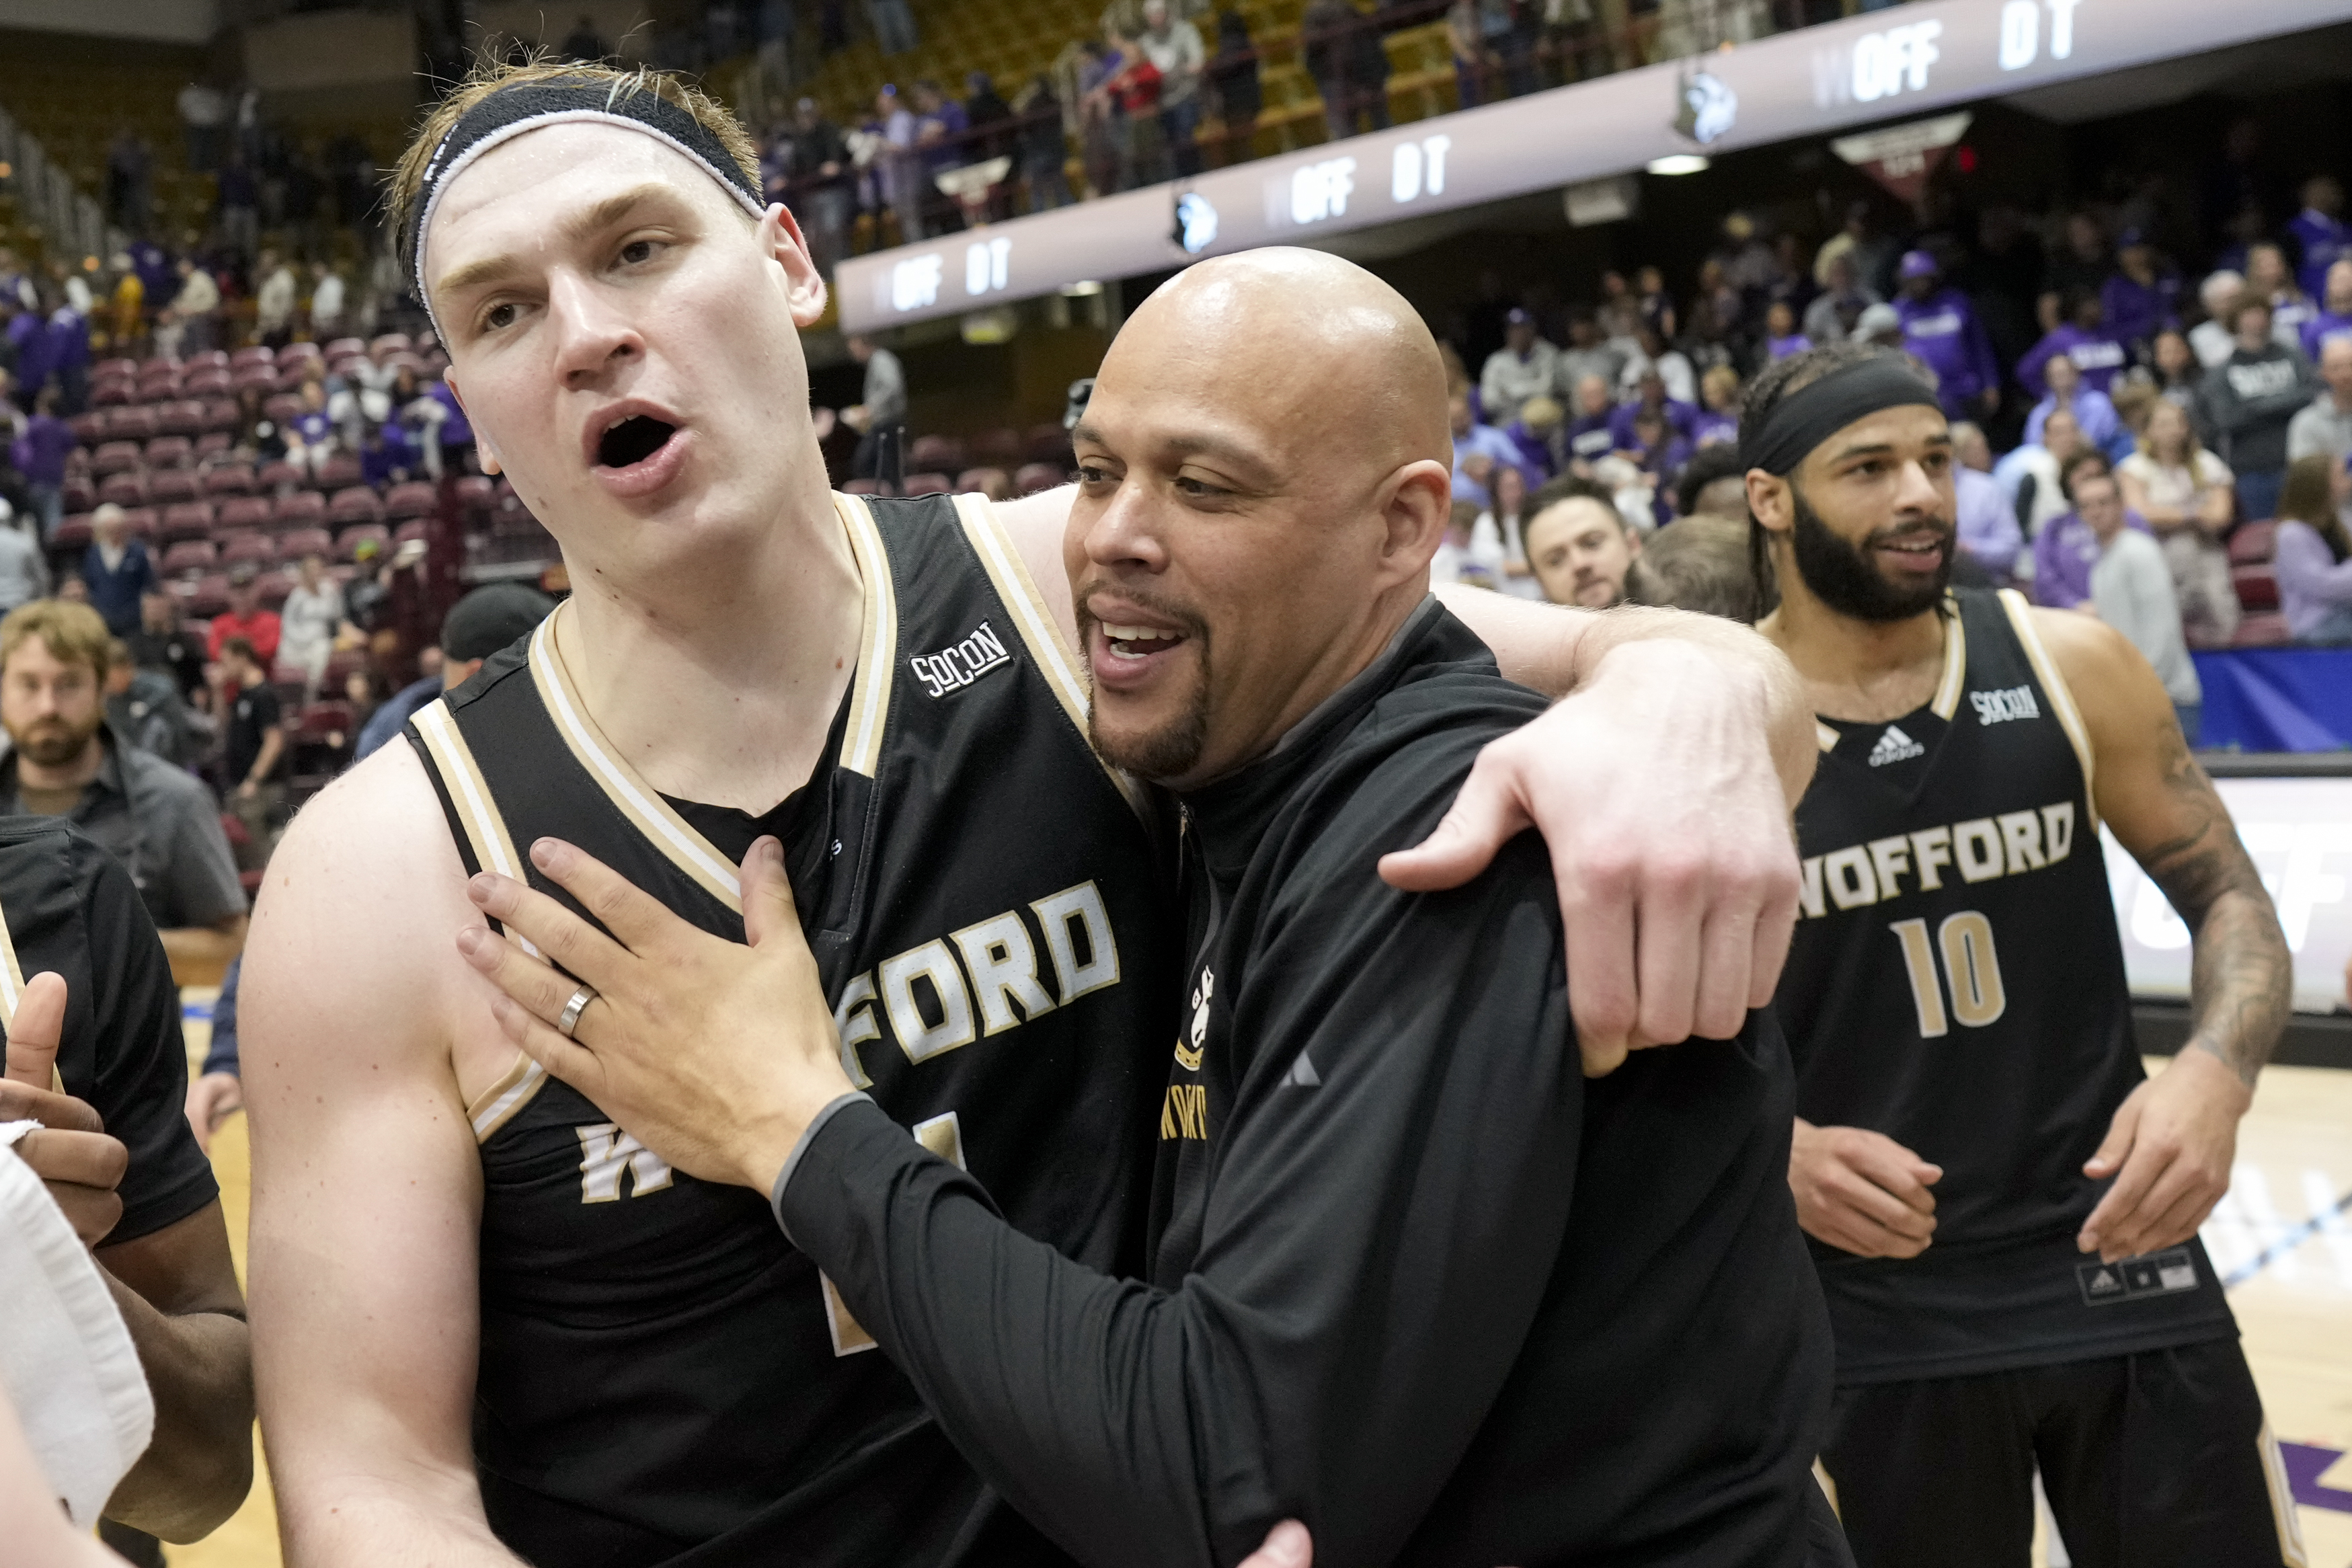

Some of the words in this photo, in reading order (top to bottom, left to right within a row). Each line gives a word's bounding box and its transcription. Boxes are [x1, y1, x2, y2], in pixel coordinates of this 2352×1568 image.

[910, 621, 1010, 698] SOCON
[1969, 684, 2040, 726] SOCON
[1888, 910, 2007, 1039] 10
